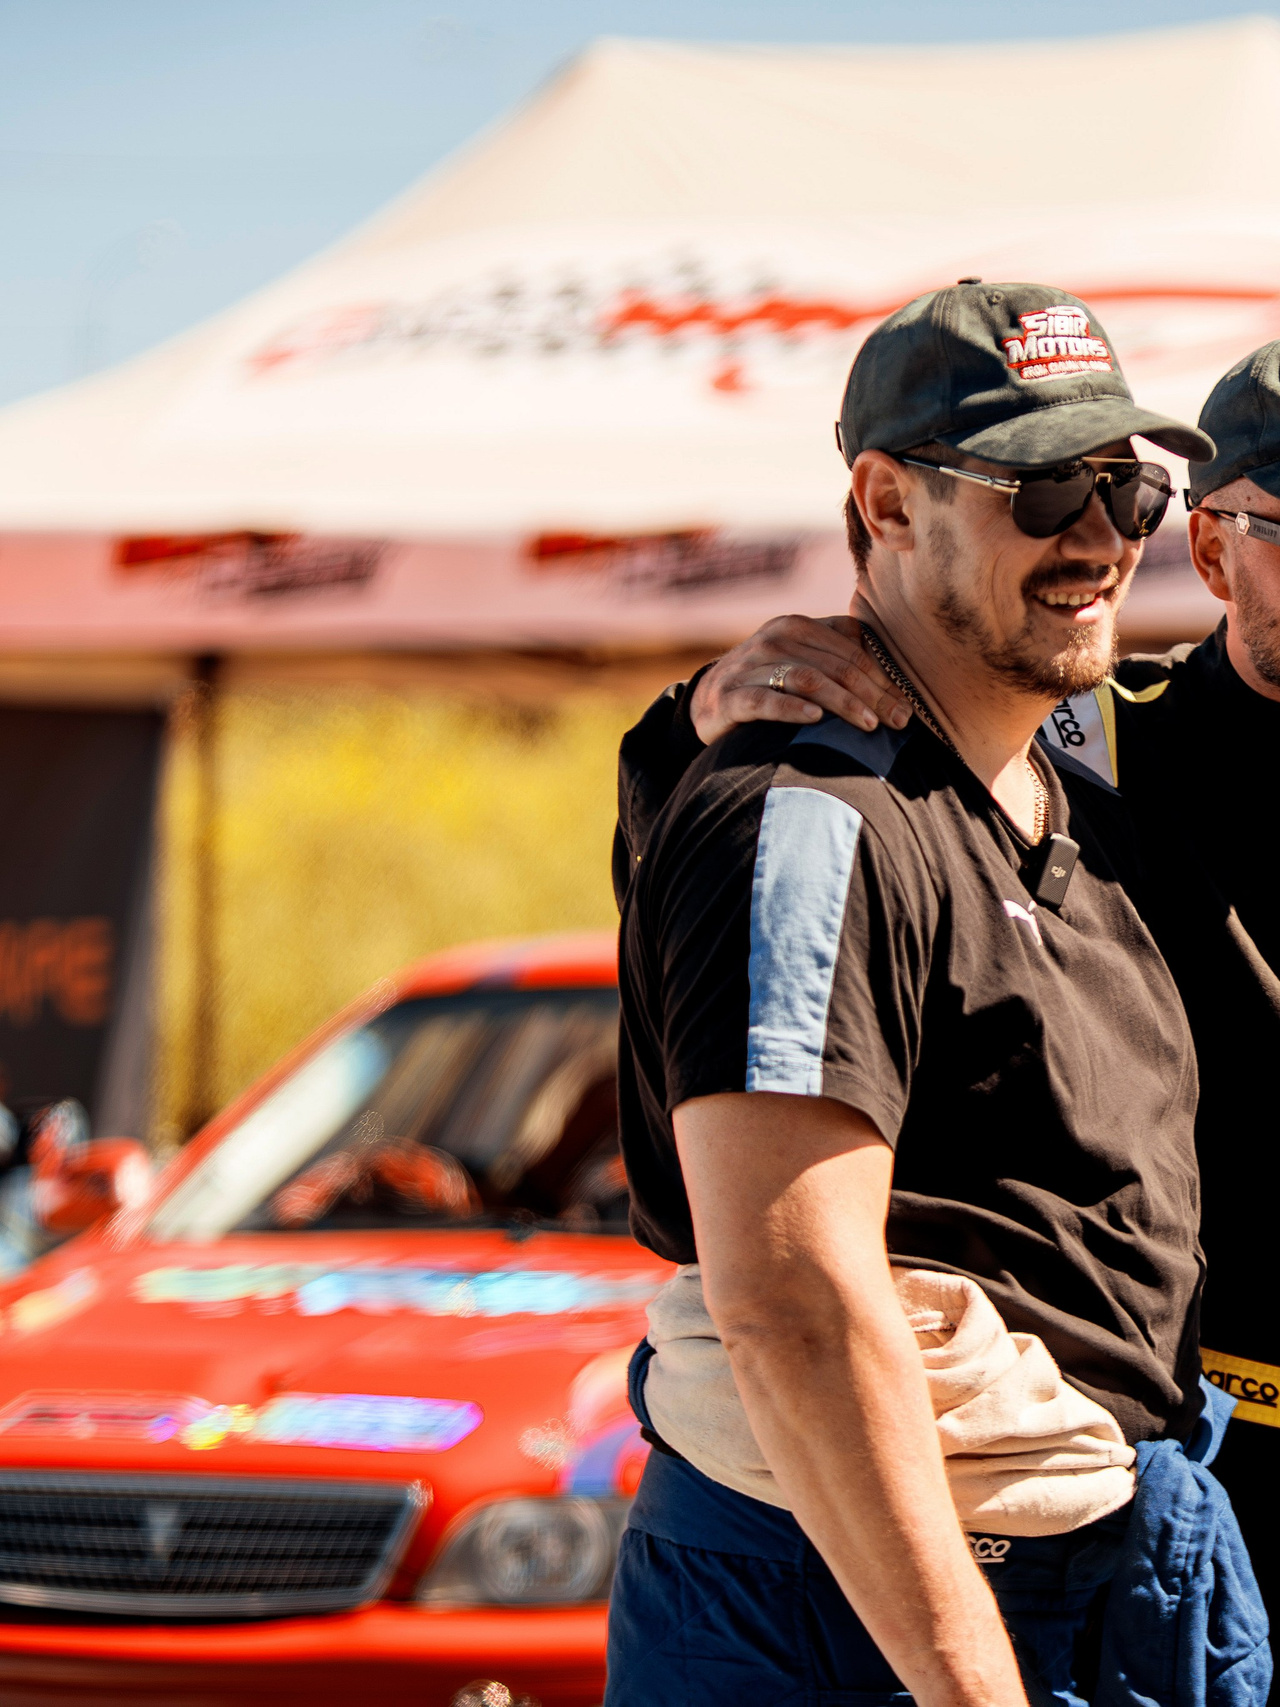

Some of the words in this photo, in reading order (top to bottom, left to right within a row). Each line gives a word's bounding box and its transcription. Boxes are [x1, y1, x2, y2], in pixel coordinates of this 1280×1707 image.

[1020, 312, 1088, 337] SIBIR
[1005, 335, 1108, 363] MOTORS
[1203, 1369, 1279, 1407] arco
